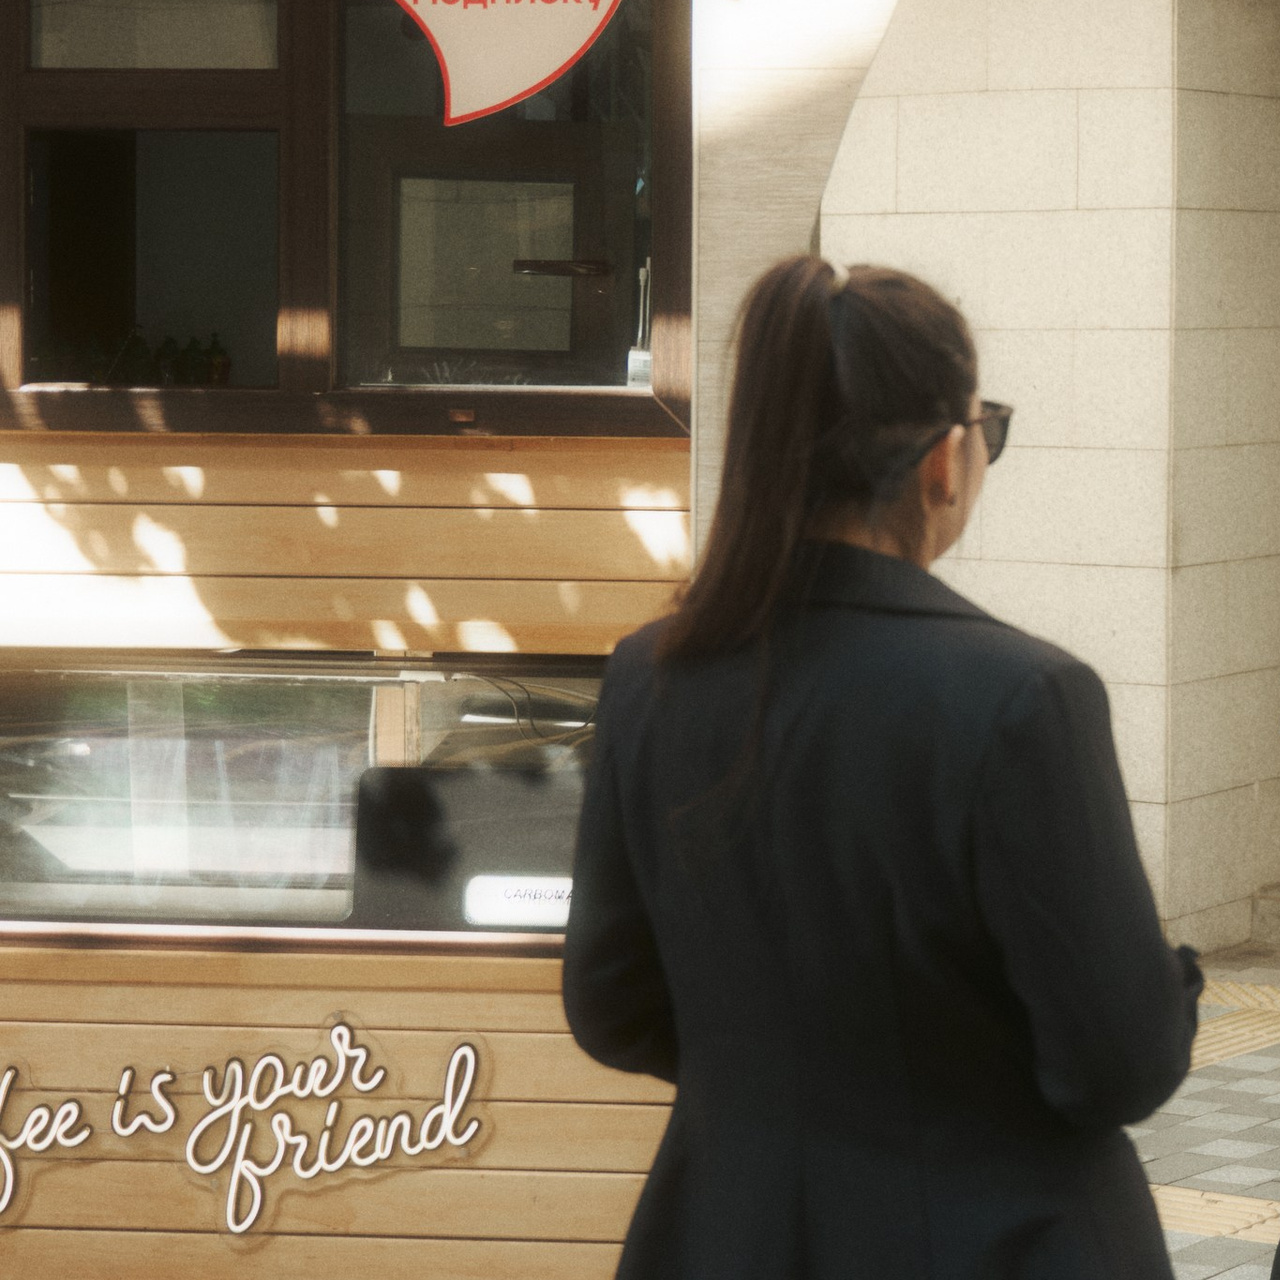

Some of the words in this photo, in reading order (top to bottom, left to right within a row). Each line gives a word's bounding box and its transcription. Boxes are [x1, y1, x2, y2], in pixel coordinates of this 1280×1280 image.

[112, 1068, 176, 1137] is
[186, 1024, 385, 1174] your
[226, 1042, 480, 1234] friend
